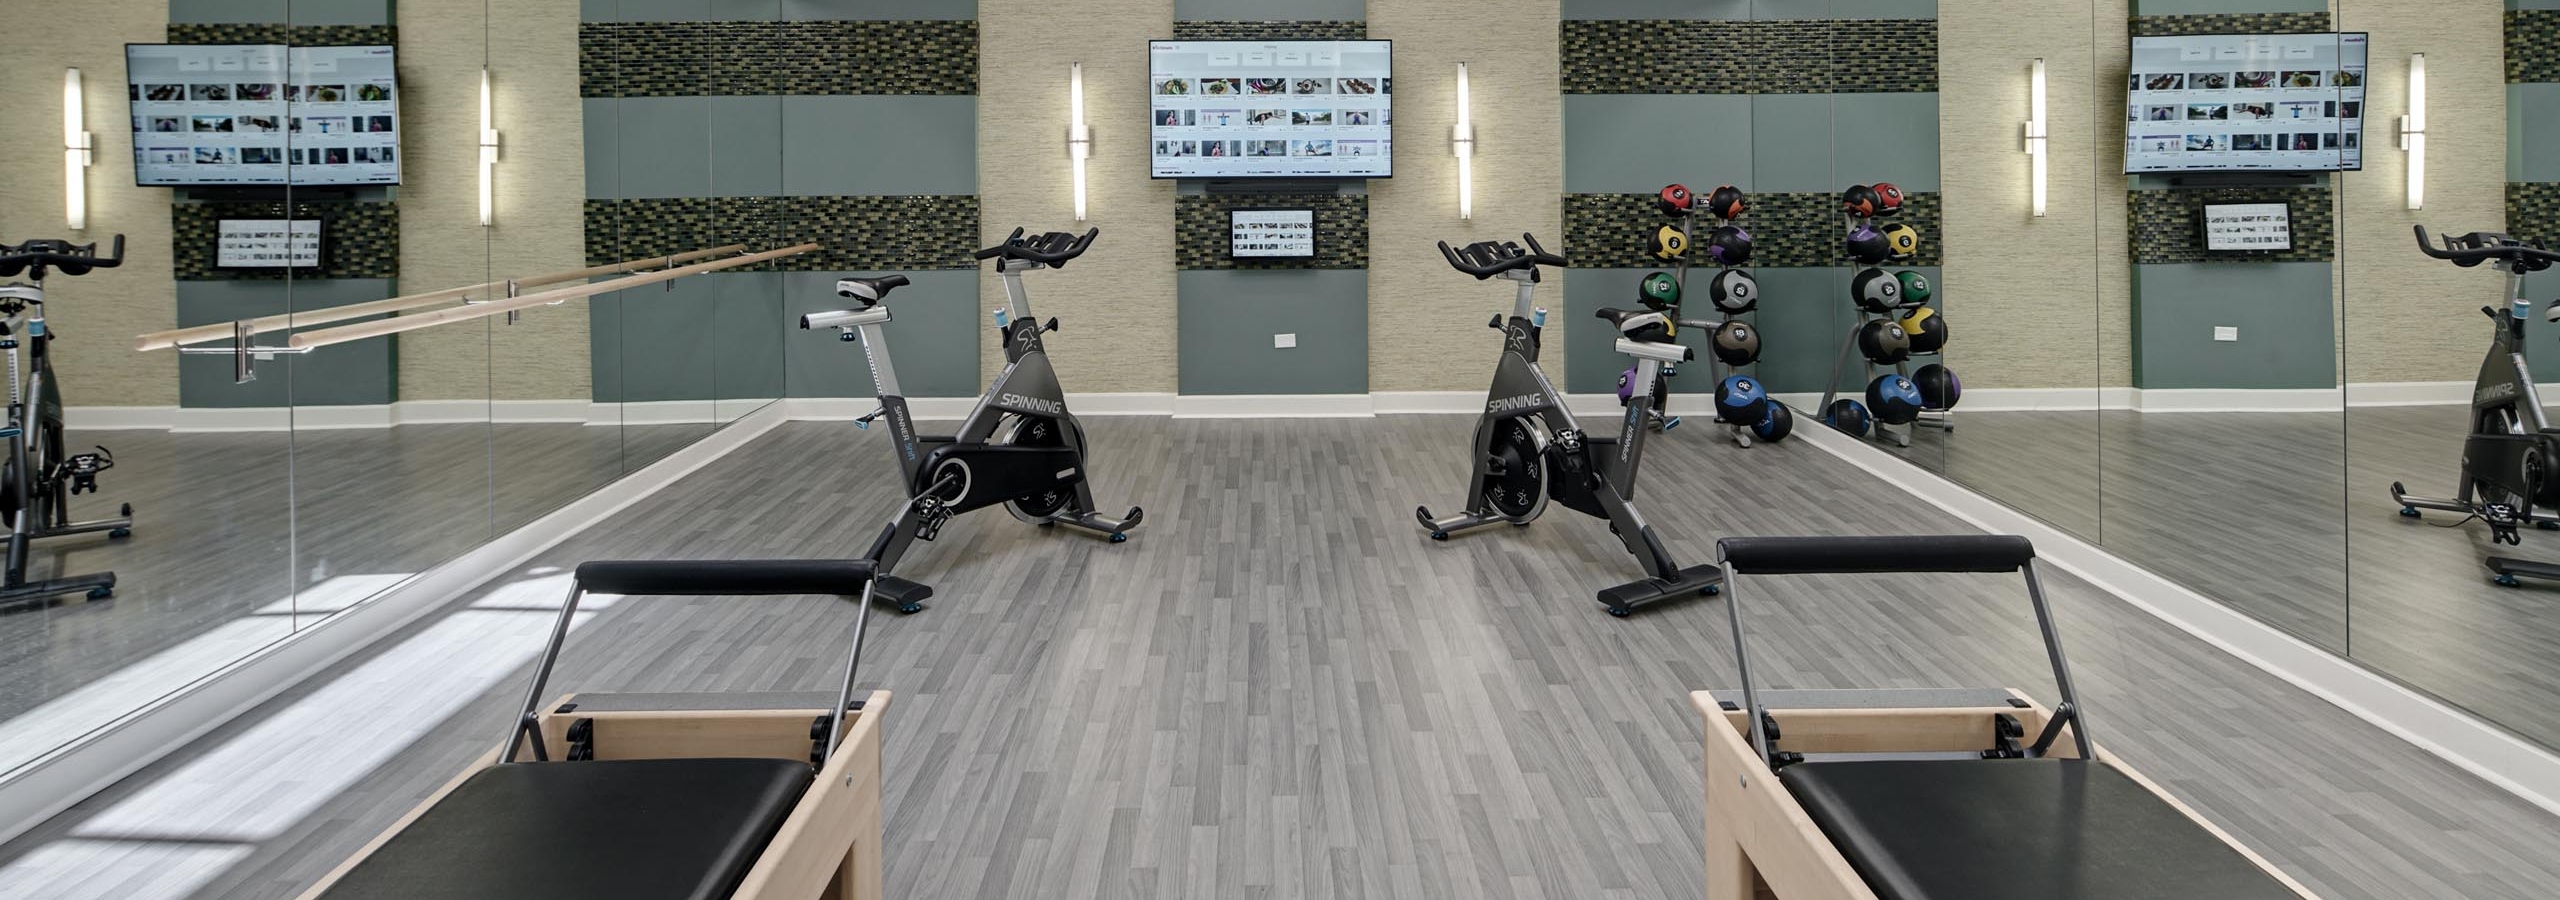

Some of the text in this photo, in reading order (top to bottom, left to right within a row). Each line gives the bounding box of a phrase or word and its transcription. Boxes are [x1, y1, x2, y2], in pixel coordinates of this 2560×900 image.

[1660, 282, 1667, 291] 12
[1000, 393, 1061, 414] SPINNING
[1489, 393, 1541, 413] SPINNING
[894, 405, 911, 442] SPINNER
[1621, 425, 1634, 463] SPINNER
